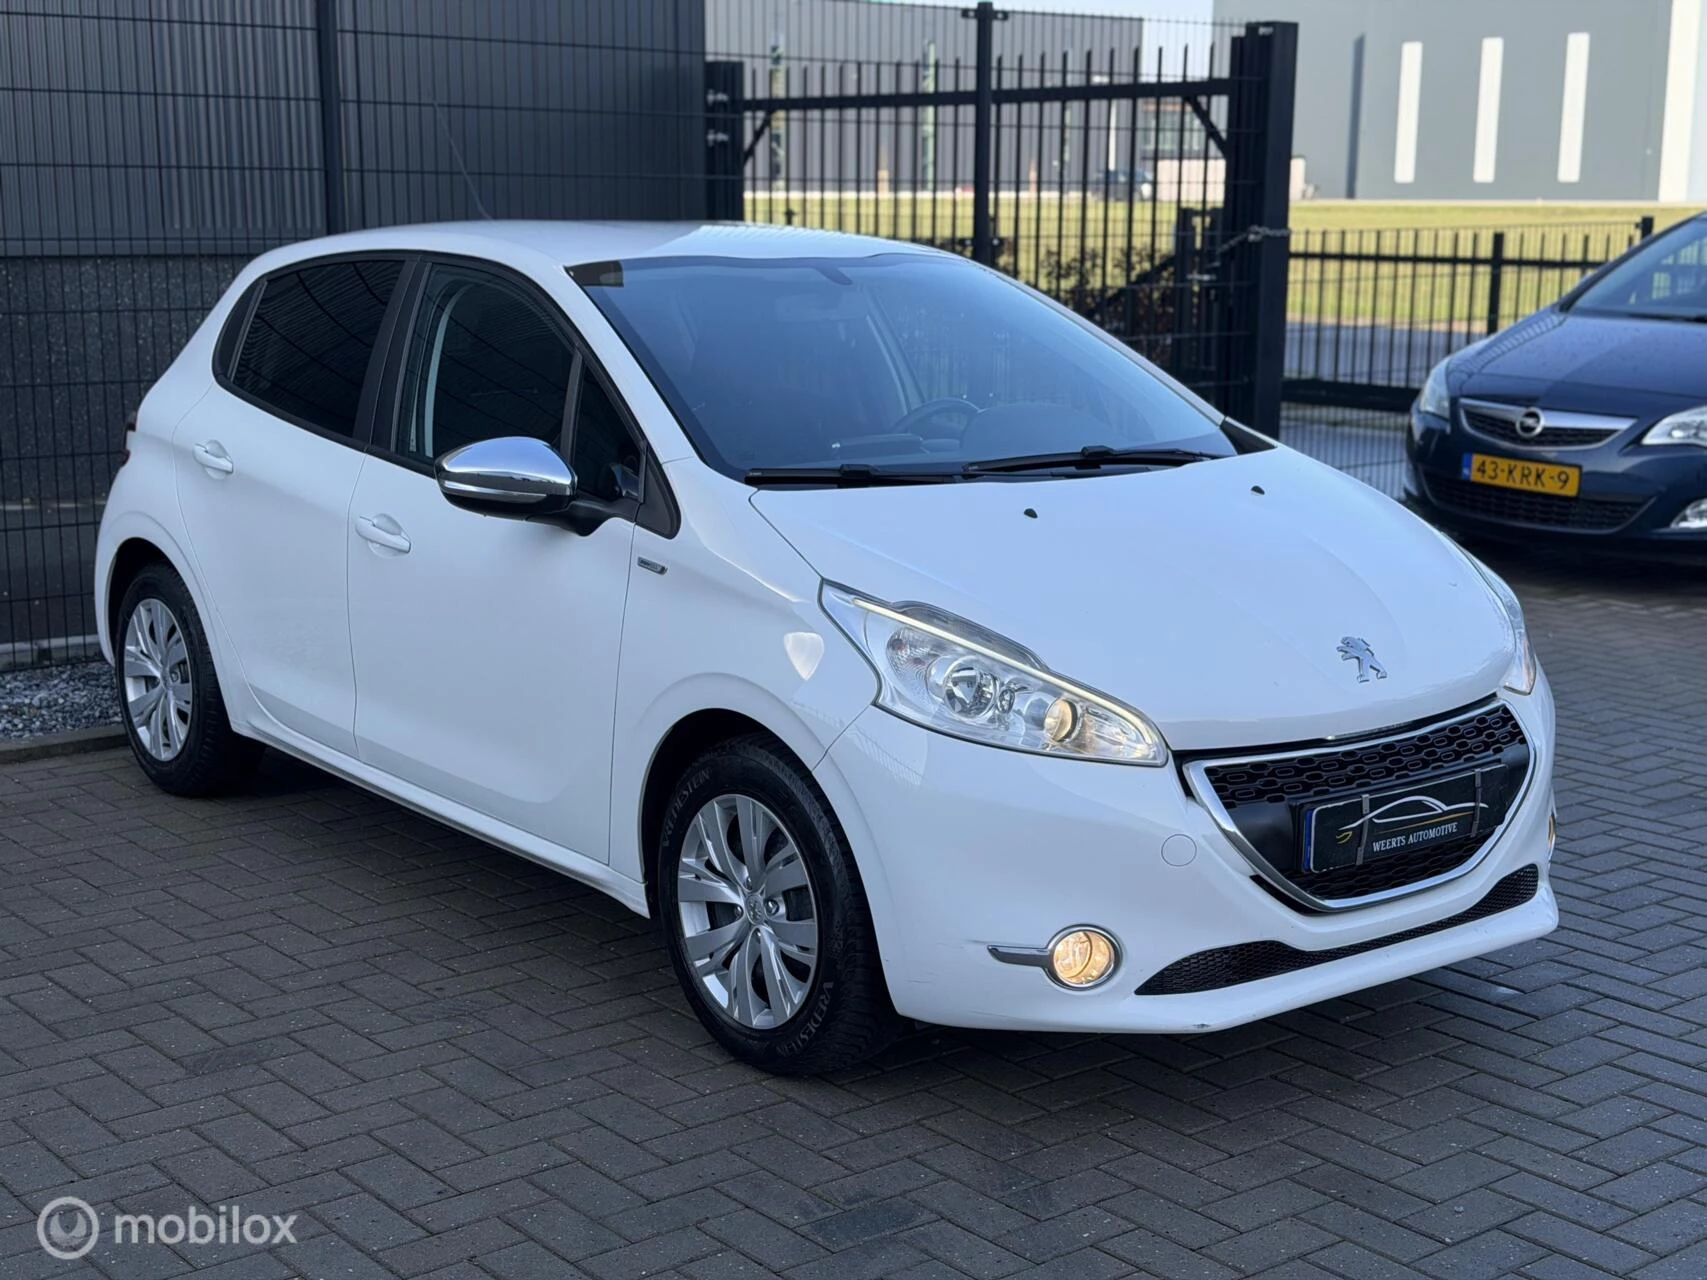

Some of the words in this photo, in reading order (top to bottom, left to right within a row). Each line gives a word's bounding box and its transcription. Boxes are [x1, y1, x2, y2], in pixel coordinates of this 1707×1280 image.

[1475, 459, 1571, 490] 43-KRK-9
[1372, 835, 1406, 852] WEERTS
[1407, 821, 1458, 844] AUTOMOTIVE
